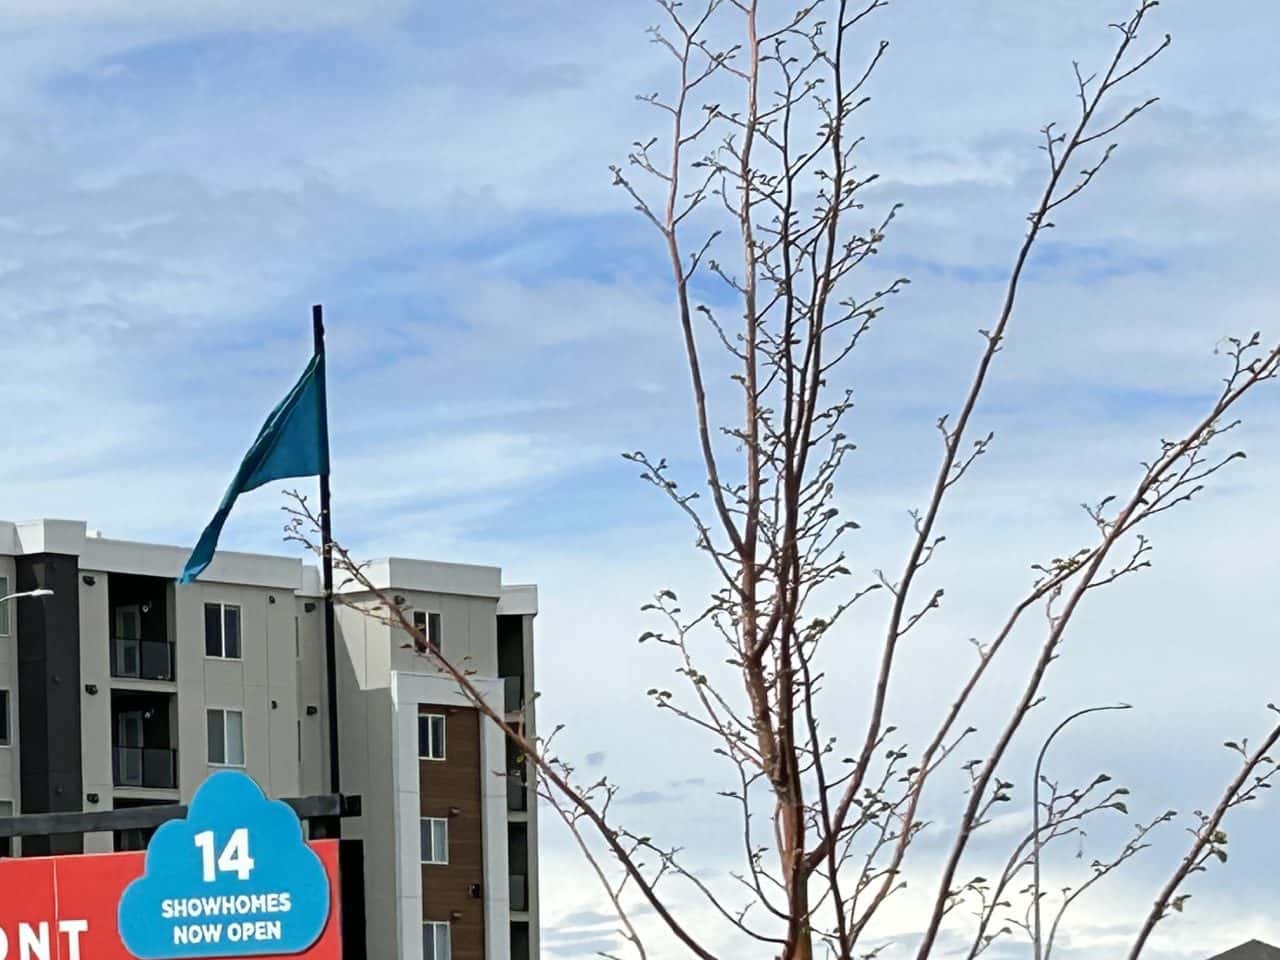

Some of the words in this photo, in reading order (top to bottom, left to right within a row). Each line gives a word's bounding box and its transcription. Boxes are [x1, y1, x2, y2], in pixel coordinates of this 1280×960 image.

[194, 828, 255, 882] 14
[161, 892, 292, 918] SHOWHOMES
[173, 924, 222, 945] NOW
[227, 920, 282, 942] OPEN
